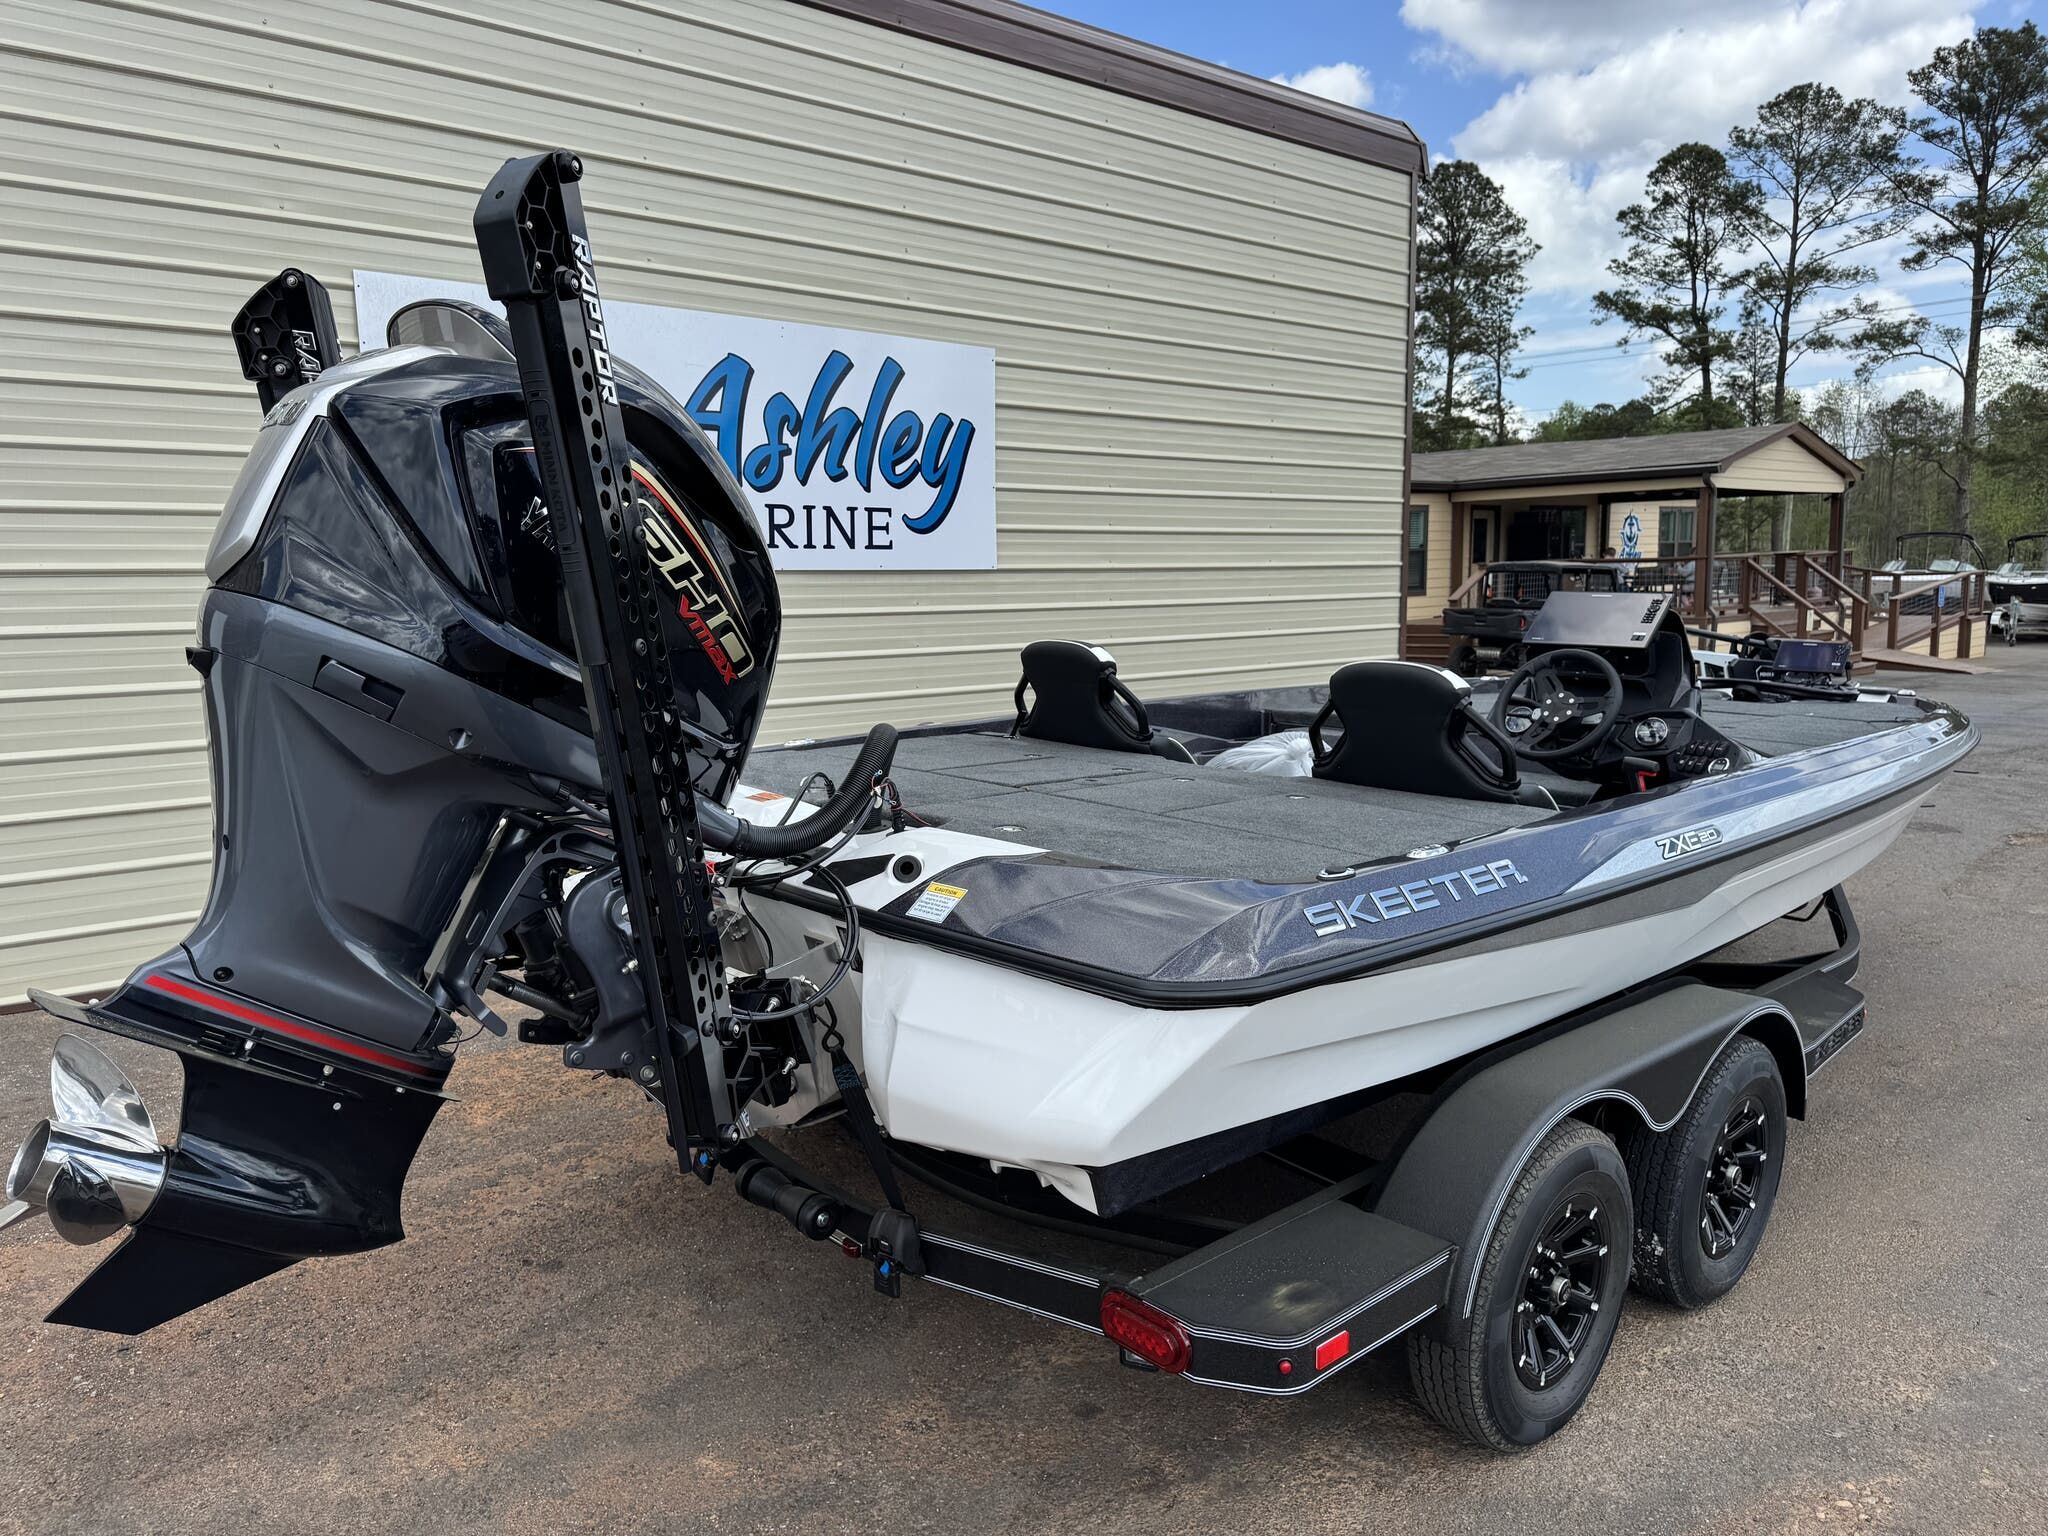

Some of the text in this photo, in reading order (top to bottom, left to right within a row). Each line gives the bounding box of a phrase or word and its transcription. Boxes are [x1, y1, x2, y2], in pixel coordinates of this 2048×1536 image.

[572, 234, 618, 407] RAPTOR
[684, 350, 976, 534] Ashley
[764, 503, 893, 550] RINE
[1303, 858, 1529, 937] SKEETER
